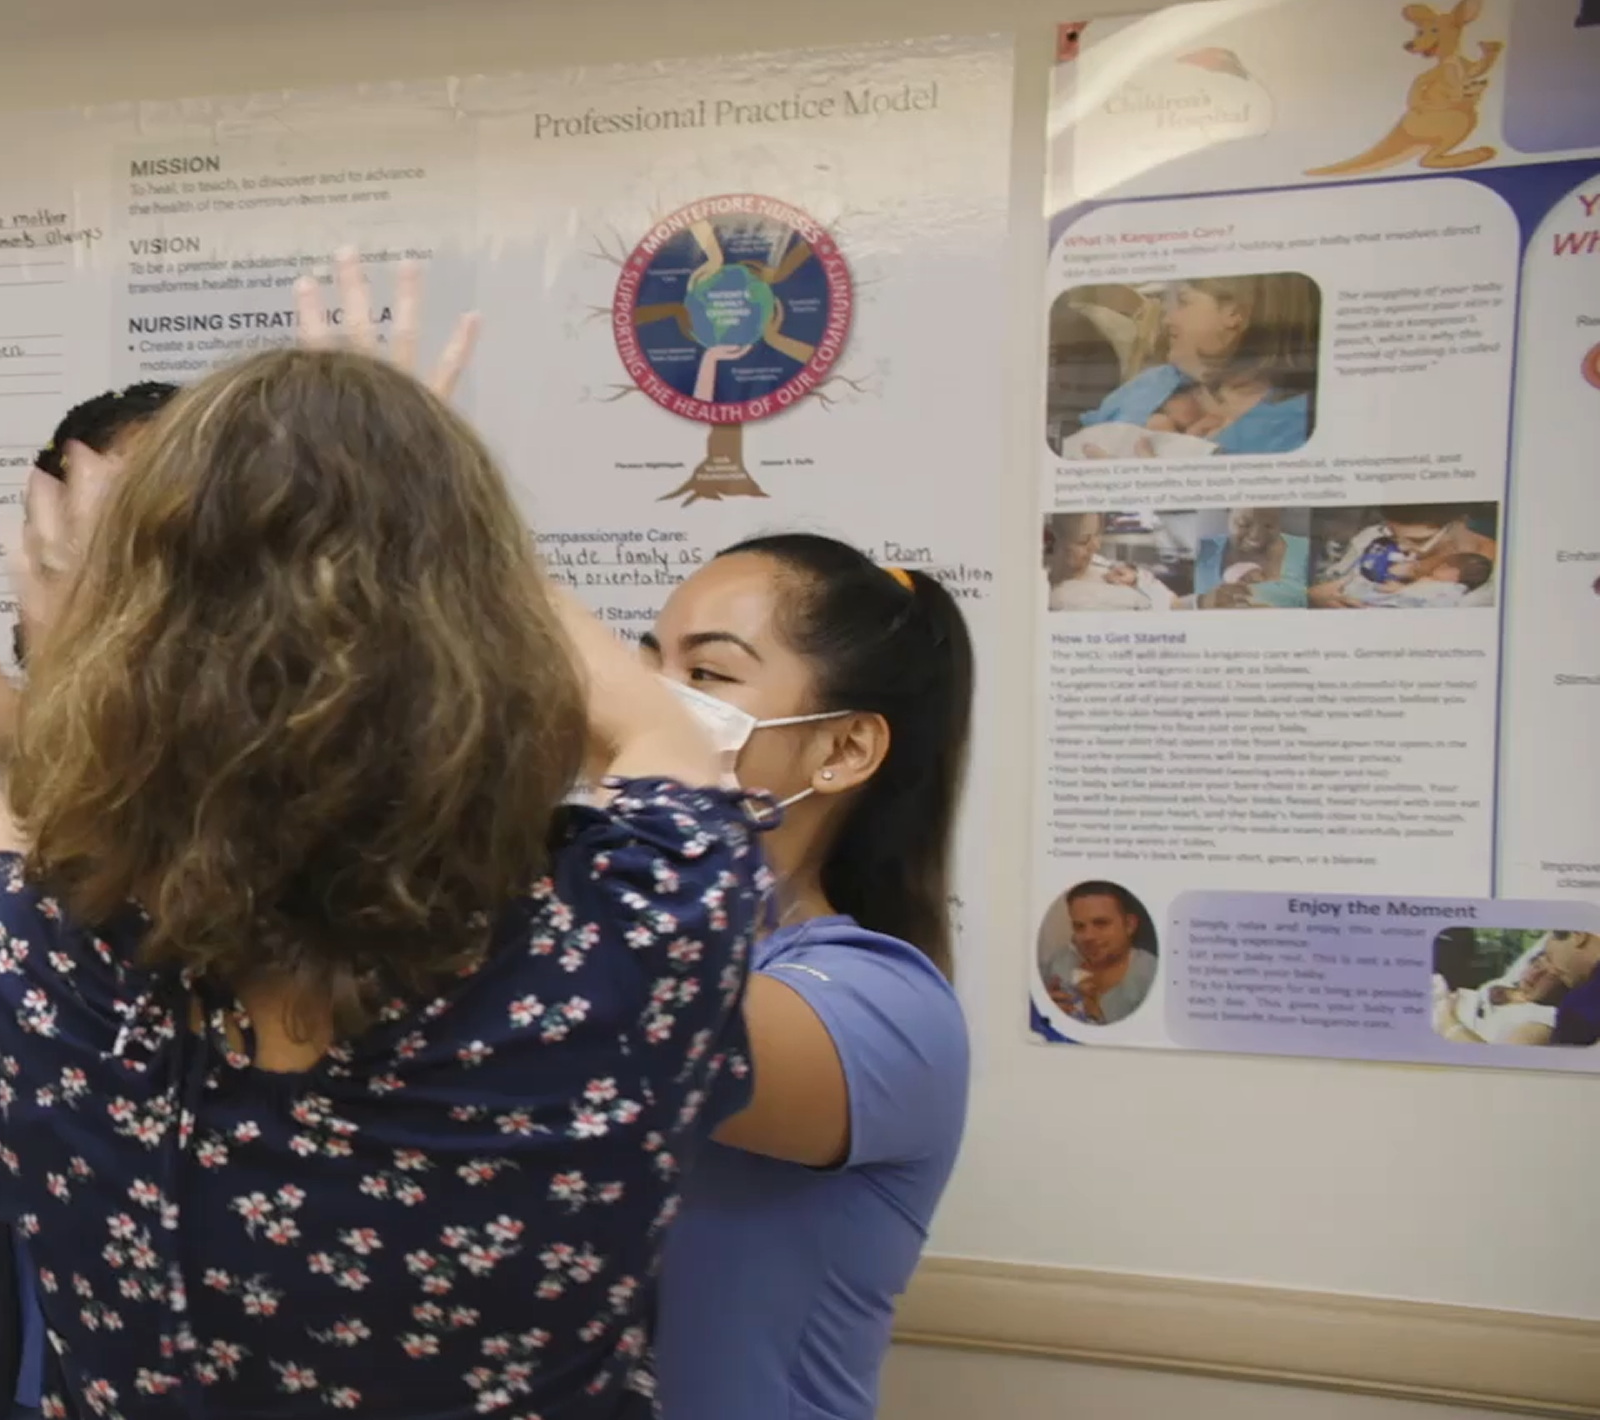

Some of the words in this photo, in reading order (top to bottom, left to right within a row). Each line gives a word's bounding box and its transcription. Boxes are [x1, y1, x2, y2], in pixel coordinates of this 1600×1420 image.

[533, 100, 707, 140] Professional
[715, 92, 836, 127] Practice
[841, 80, 940, 118] Model
[130, 154, 221, 177] MISSION
[642, 196, 757, 255] MONTEFIORE
[759, 197, 824, 246] NURSES
[129, 235, 201, 256] VISION
[615, 268, 645, 375] SUPPORTING
[811, 250, 850, 374] COMMUNITY
[128, 314, 224, 334] NURSING
[640, 374, 671, 404] THE
[671, 395, 742, 421] HEALTH
[748, 396, 776, 417] OF
[775, 375, 814, 402] OUR
[645, 527, 688, 543] Care:
[1051, 631, 1084, 646] How
[1086, 631, 1101, 646] to
[1104, 631, 1131, 646] Get
[1133, 631, 1187, 646] Started
[1288, 898, 1342, 918] Enjoy
[1347, 899, 1381, 917] the
[1386, 902, 1478, 920] Moment
